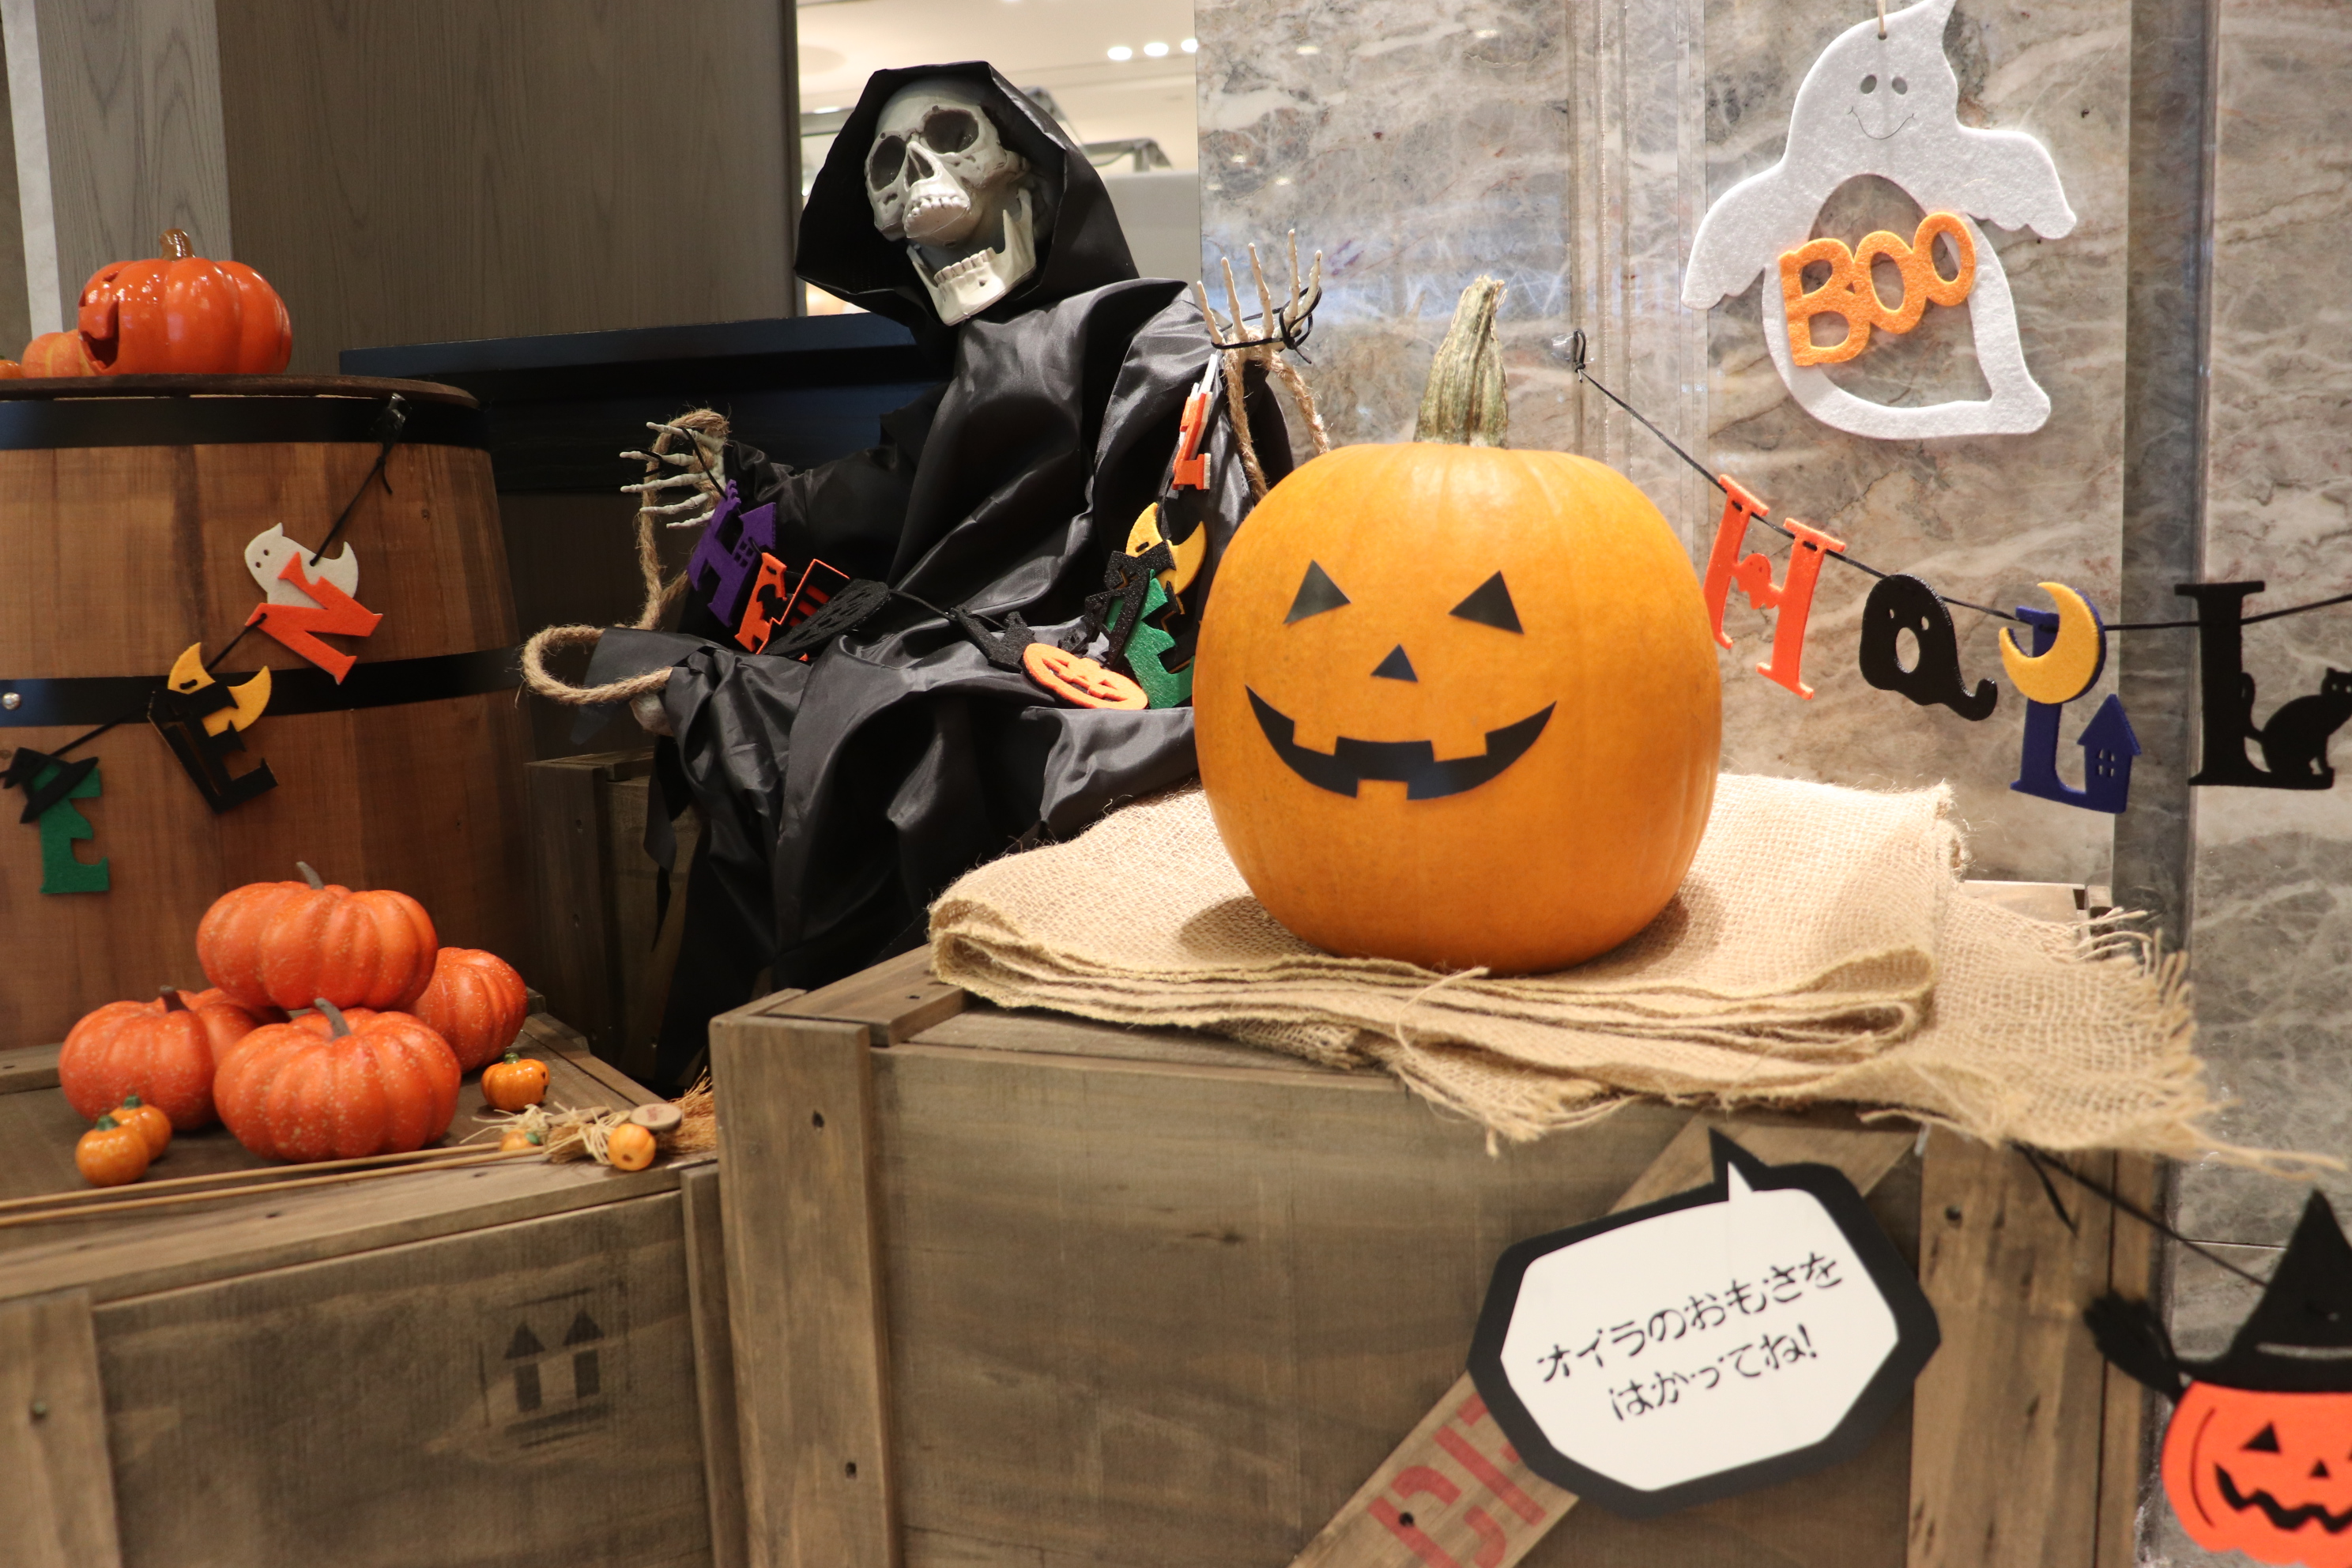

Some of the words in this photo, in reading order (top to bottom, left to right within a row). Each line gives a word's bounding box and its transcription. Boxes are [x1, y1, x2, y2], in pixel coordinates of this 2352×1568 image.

[1777, 210, 1976, 367] BOO
[1536, 1251, 1843, 1383] オイラのおもさを
